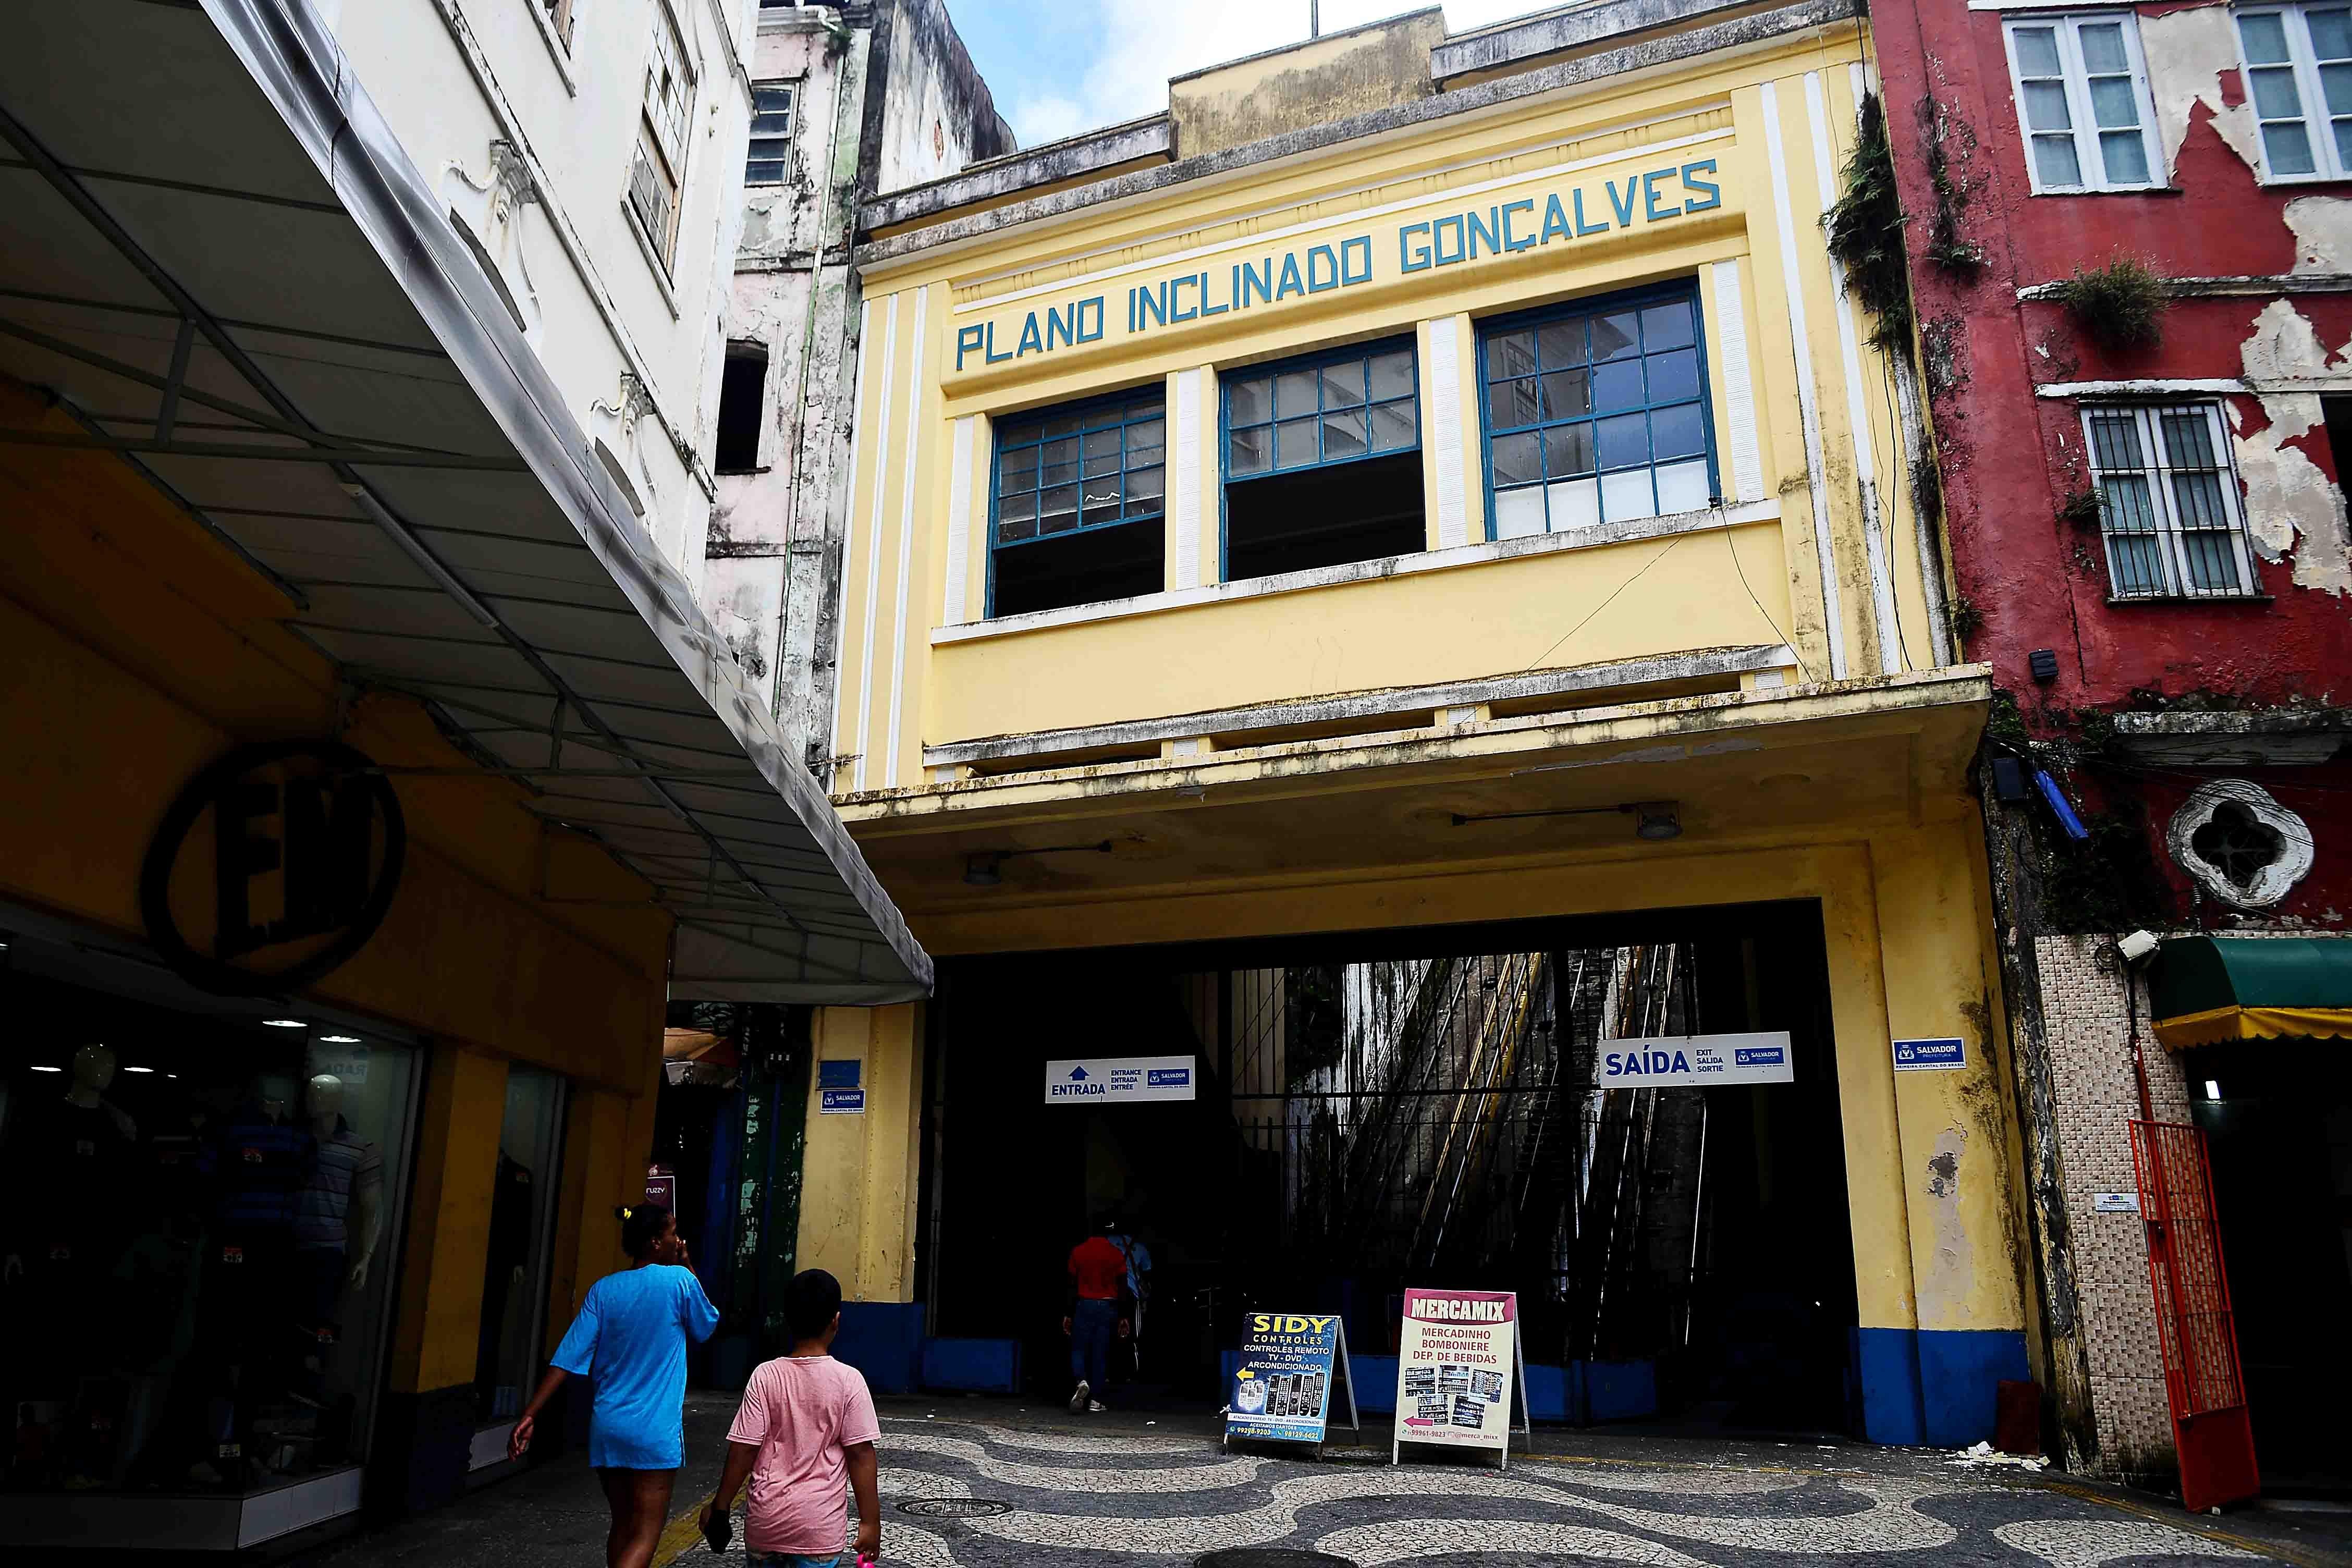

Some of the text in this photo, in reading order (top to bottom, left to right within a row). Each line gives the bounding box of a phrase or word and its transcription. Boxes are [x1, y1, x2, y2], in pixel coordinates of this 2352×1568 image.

[957, 158, 1721, 371] PLANO INCLINADO GONÇALVES
[1916, 1045, 1956, 1054] SALVADOR
[1605, 1044, 1692, 1076] SAÍDA
[1051, 1084, 1106, 1096] ENTRADA
[1111, 1082, 1134, 1091] ENTRÉE
[1411, 1298, 1505, 1322] MERCAMIX
[1253, 1315, 1332, 1334] SIDY
[1253, 1334, 1322, 1345] CONTROLES
[1422, 1327, 1491, 1340] MERCADINHO
[1244, 1344, 1330, 1355] CONTROLES REMOTO
[1422, 1340, 1489, 1352] BOMBONIERE
[1413, 1350, 1497, 1364] DEP. DE BEBIDAS
[1247, 1361, 1322, 1371] ARCONDICIONADO
